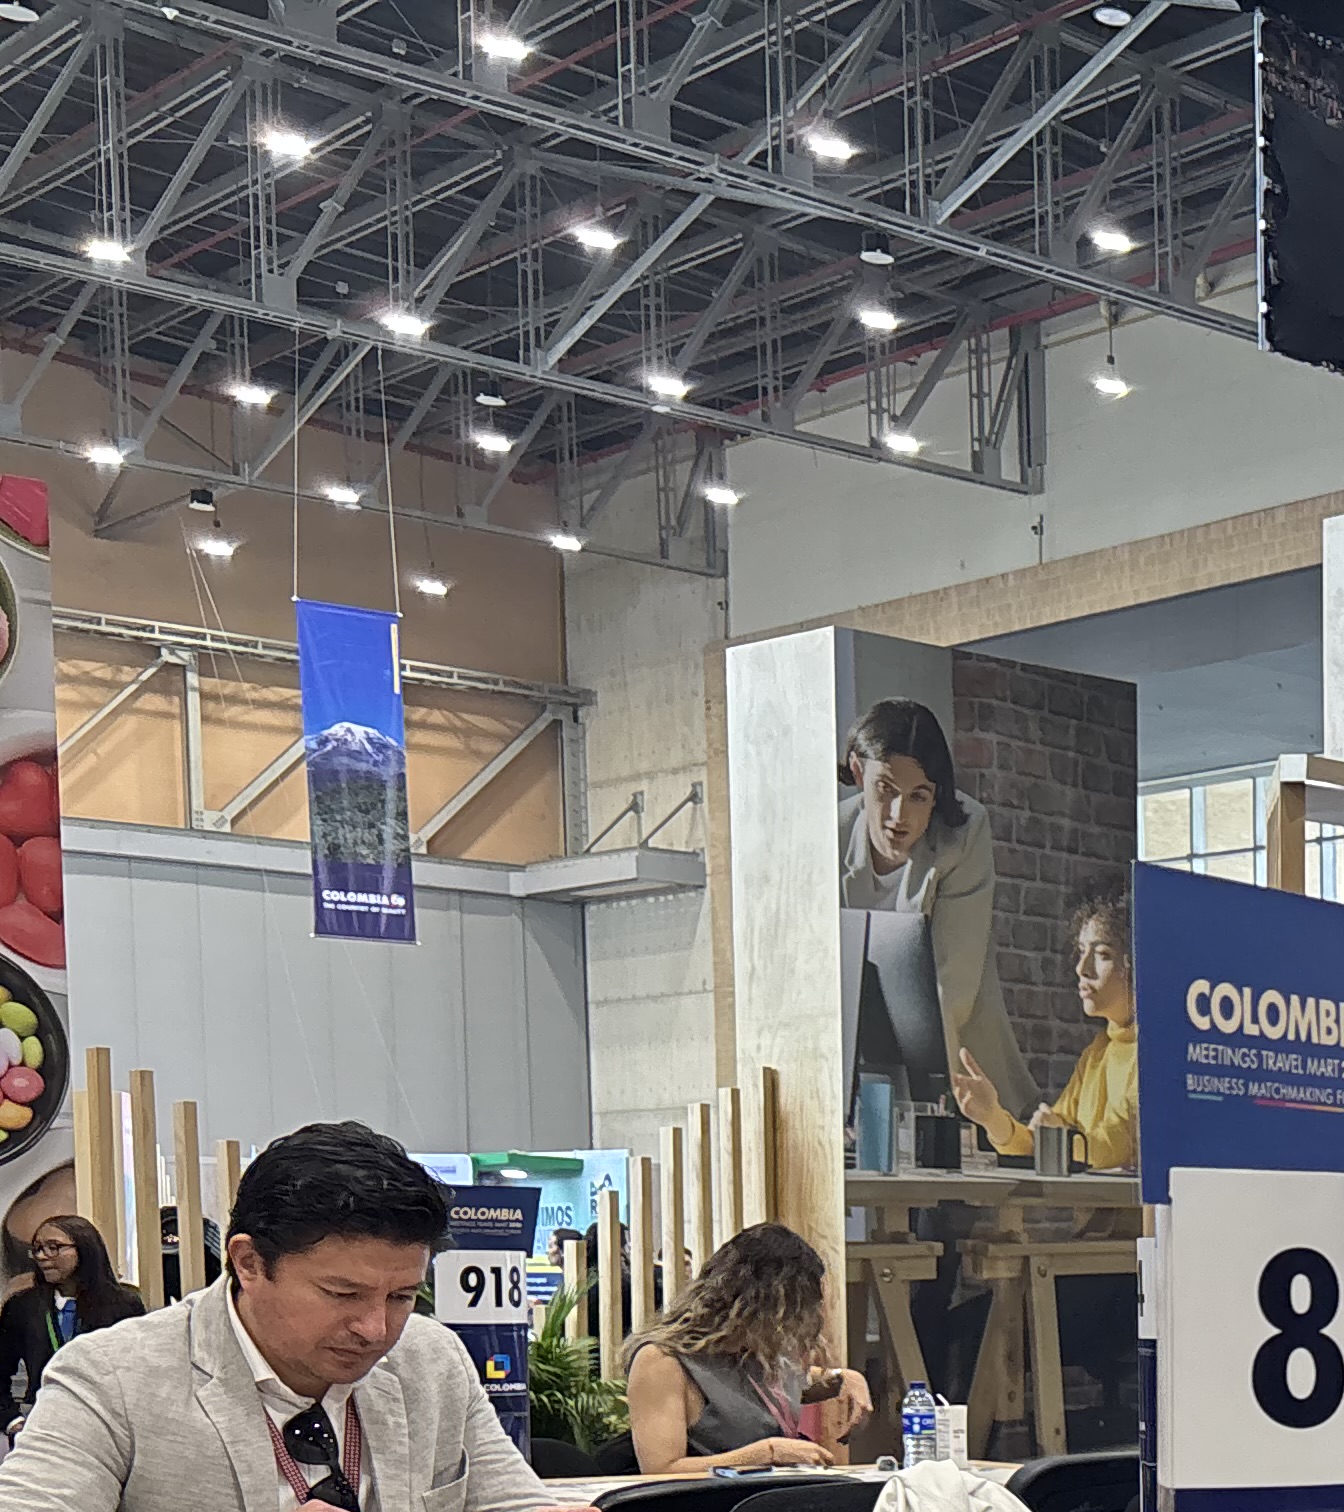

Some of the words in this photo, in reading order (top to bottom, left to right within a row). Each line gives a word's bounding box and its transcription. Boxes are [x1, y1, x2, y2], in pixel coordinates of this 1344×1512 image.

[322, 889, 389, 906] COLOMBIA
[1187, 1042, 1259, 1070] MEETINGS
[1261, 1049, 1304, 1075] TRAVEL
[1306, 1058, 1340, 1078] MART
[1186, 1073, 1245, 1097] BUSINESS
[1248, 1081, 1335, 1104] MATCHMAKING
[450, 1206, 523, 1221] COLOMBIA
[459, 1265, 523, 1309] 918
